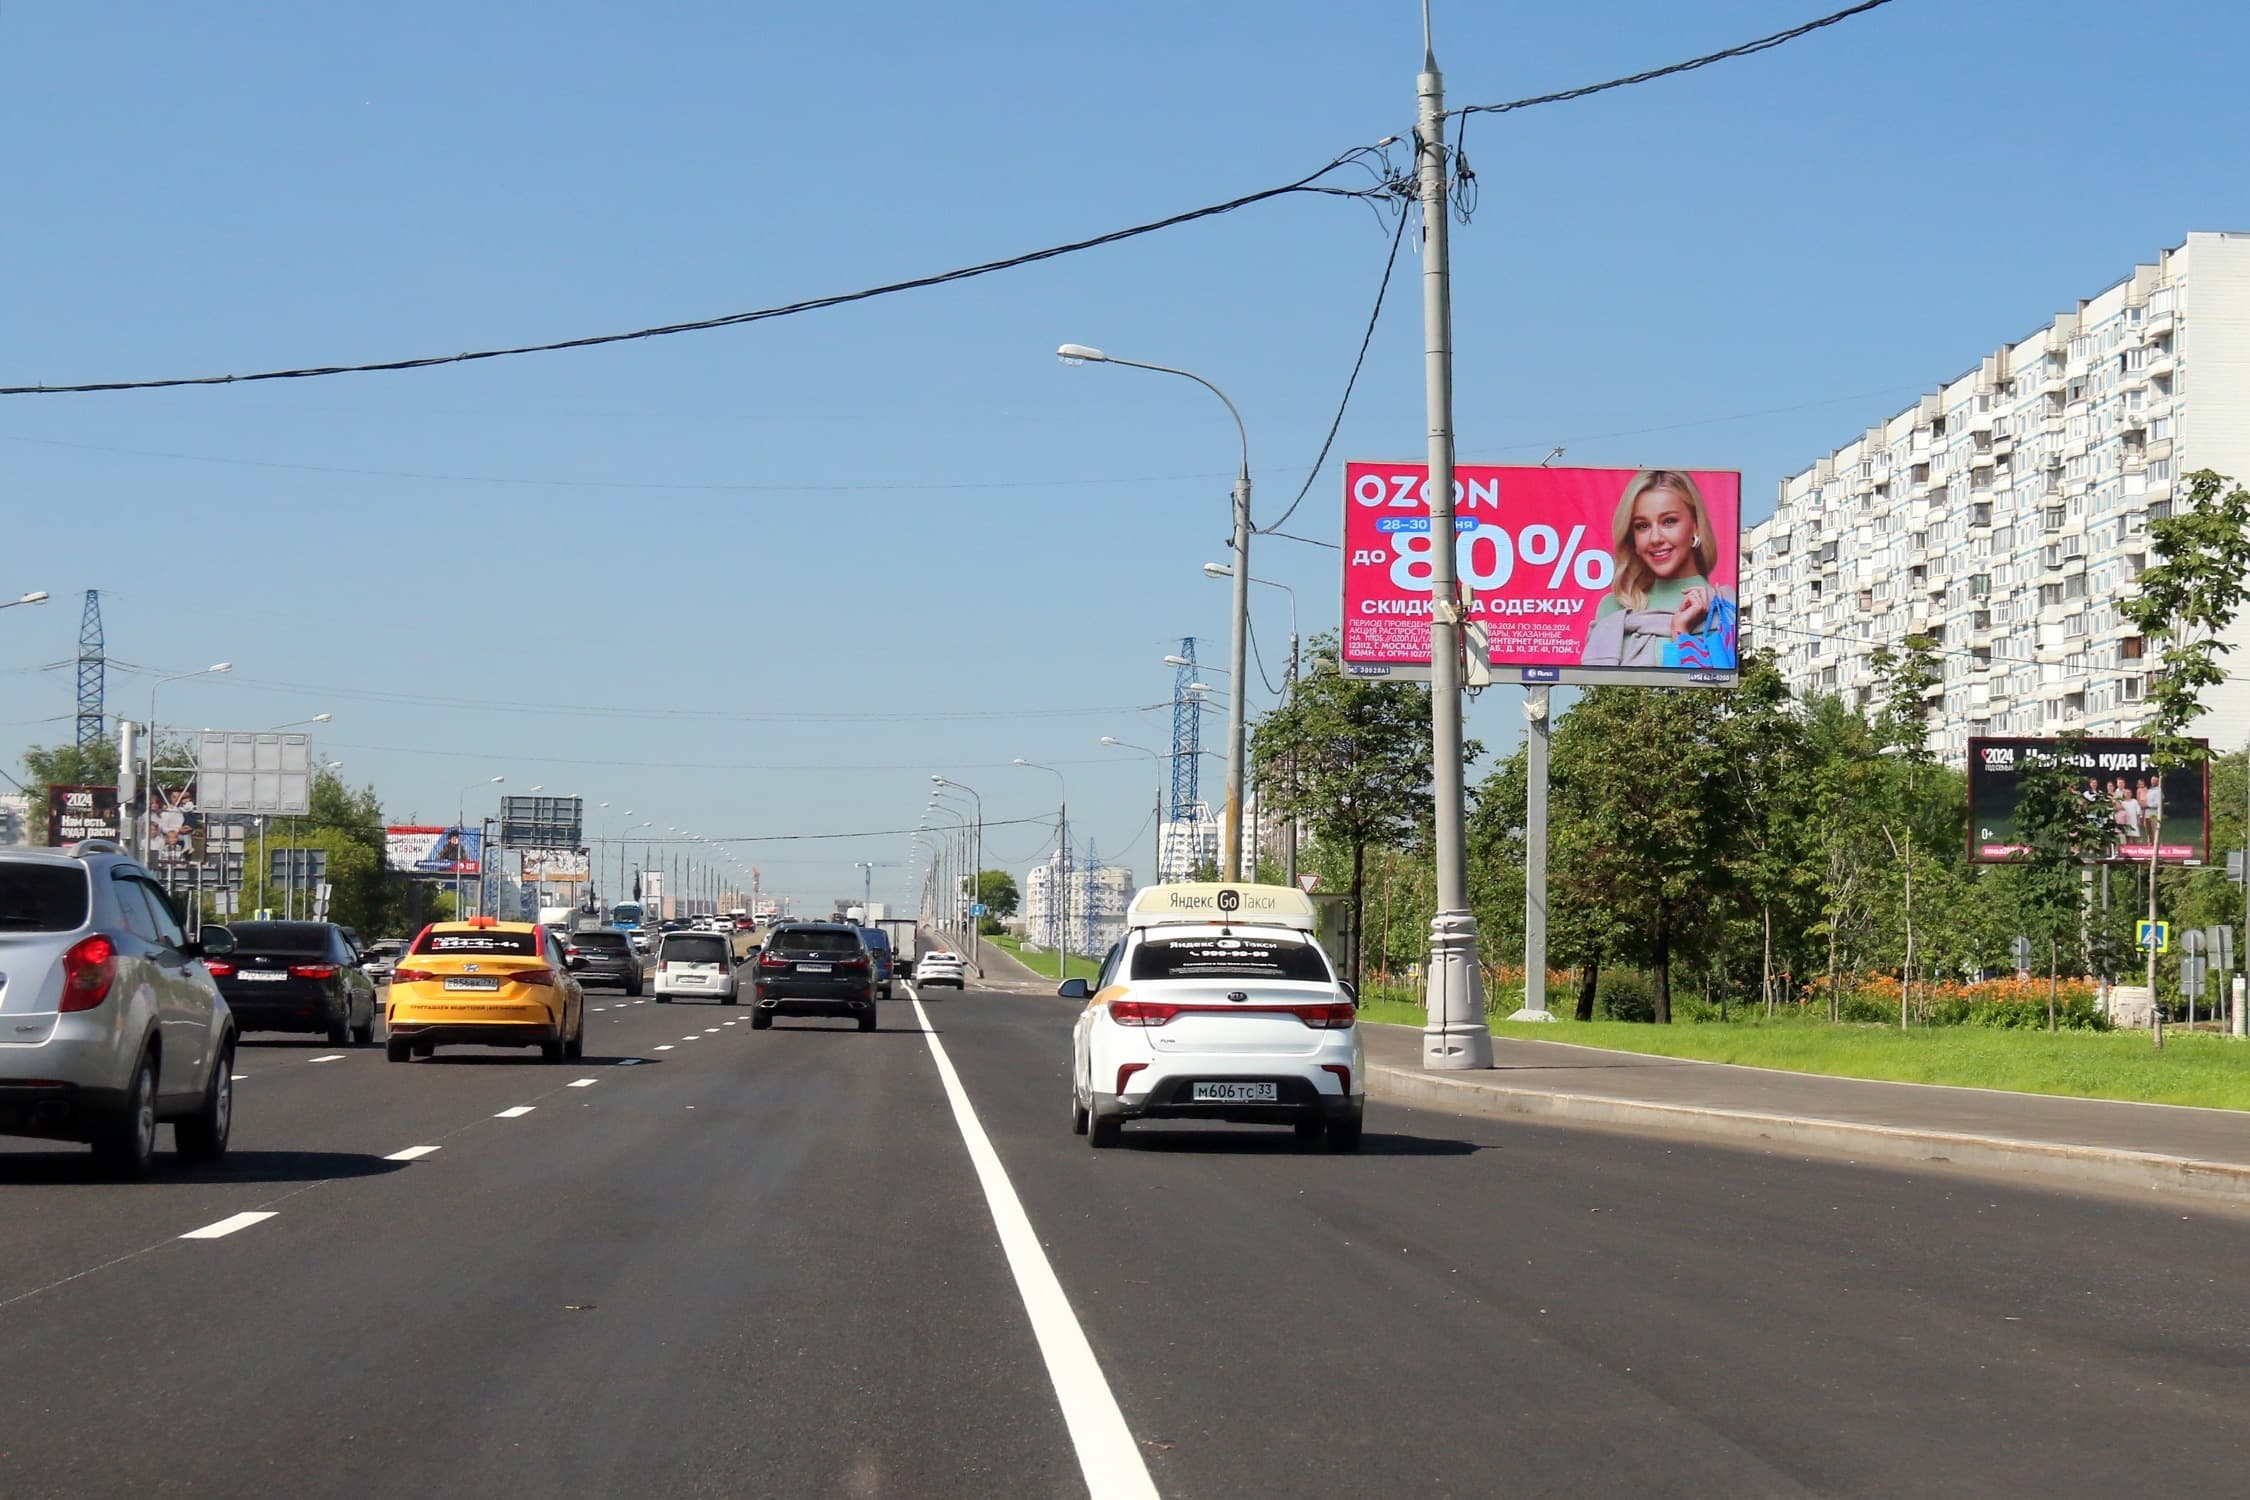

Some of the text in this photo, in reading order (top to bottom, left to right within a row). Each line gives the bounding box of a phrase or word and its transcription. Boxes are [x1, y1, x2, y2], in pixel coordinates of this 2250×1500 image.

[1354, 474, 1498, 509] OZON
[1352, 523, 1615, 592] до 80%
[1361, 599, 1434, 616] СКИДК
[1490, 599, 1585, 616] ОДЕЖДУ
[1349, 619, 1382, 627] ПЕРИОД
[1349, 627, 1377, 635] АКЦИЯ
[1512, 631, 1563, 639] УКАЗАННЫЕ
[1985, 748, 2014, 764] 2024
[2099, 753, 2137, 771] куда
[66, 793, 93, 807] 2024
[62, 815, 106, 827] Нам есть
[61, 828, 116, 840] куда расти
[1981, 828, 1994, 840] 0+
[1170, 893, 1276, 909] Яндекс Go Такси
[1258, 1084, 1272, 1095] 33
